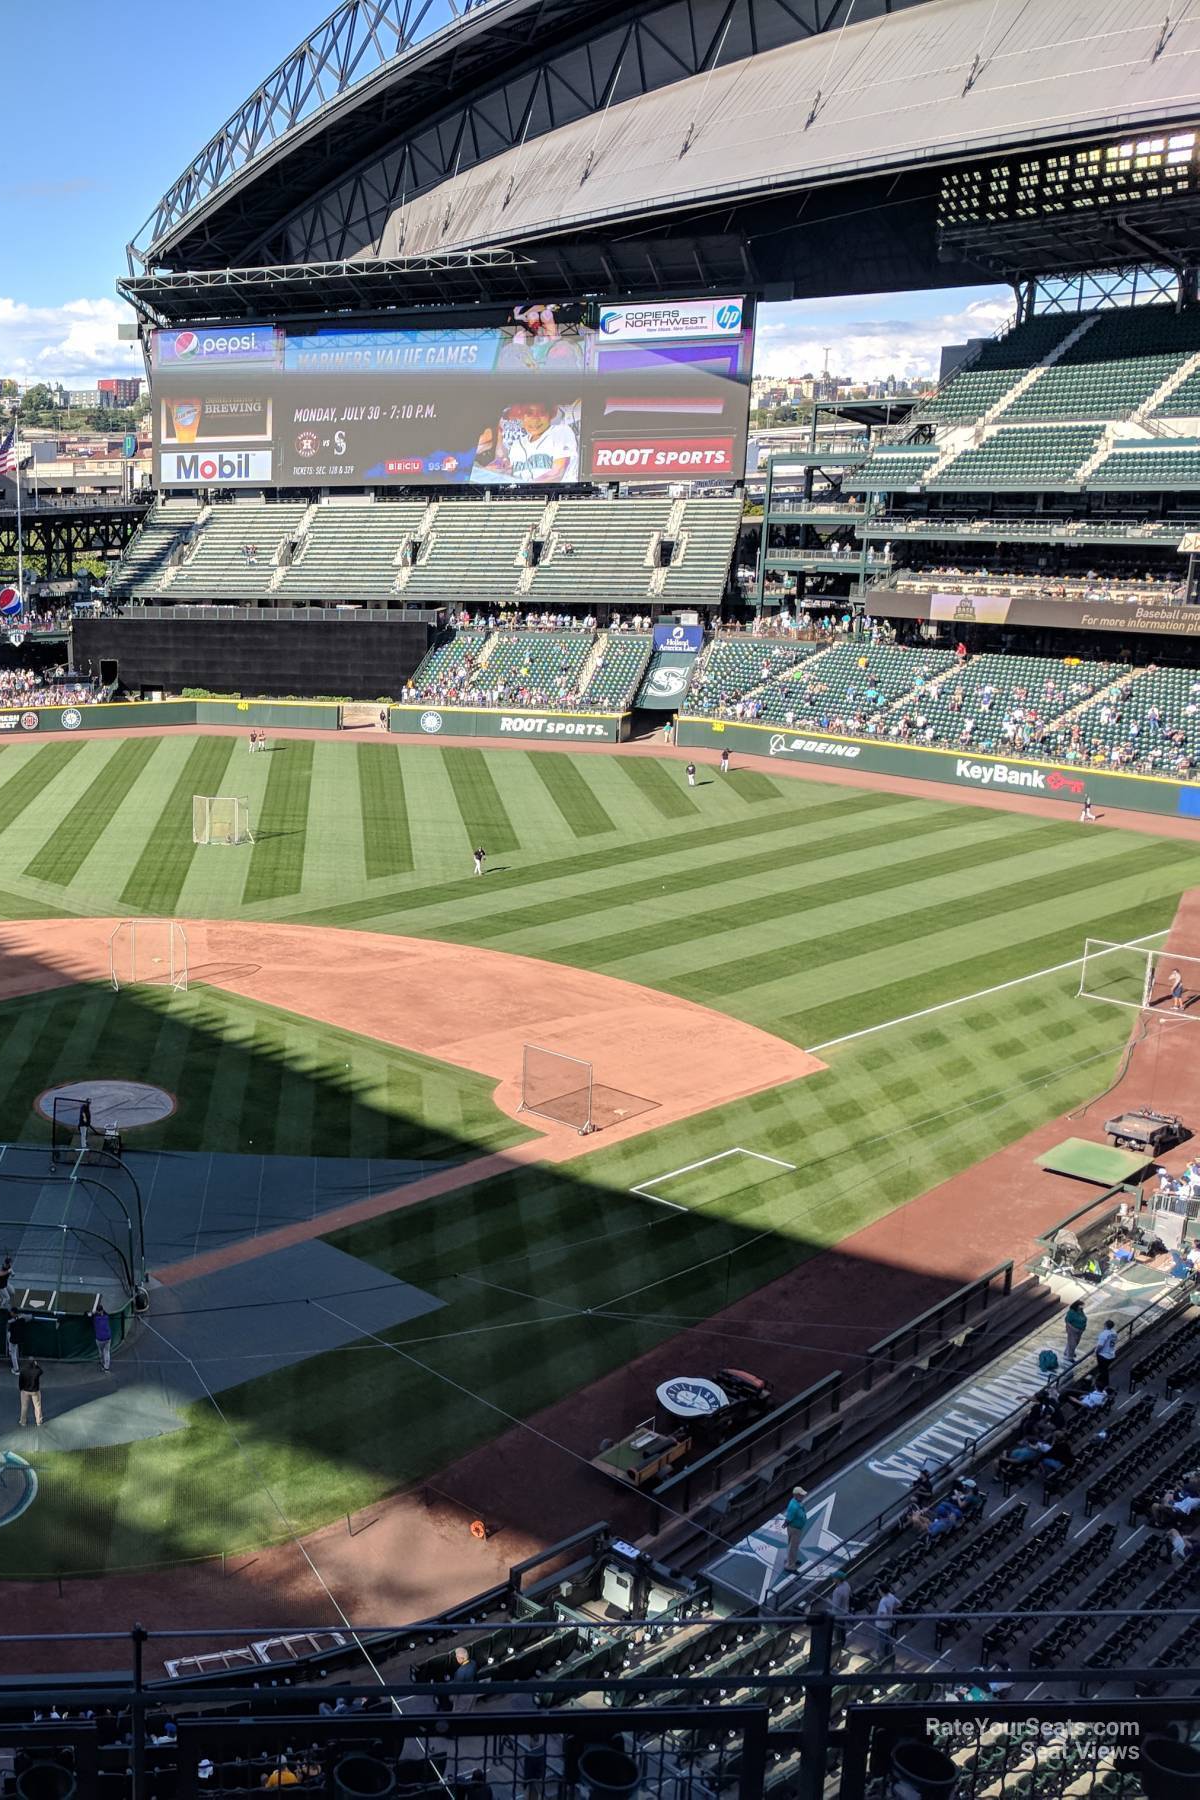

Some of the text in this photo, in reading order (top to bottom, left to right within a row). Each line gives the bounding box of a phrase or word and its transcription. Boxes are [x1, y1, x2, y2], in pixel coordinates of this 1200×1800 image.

[625, 310, 680, 320] COPIERS
[625, 316, 707, 328] NORTHWEST
[719, 305, 739, 330] hp
[203, 333, 256, 355] pepsi
[425, 346, 478, 364] GAMES
[204, 402, 261, 414] BREWING
[294, 407, 337, 423] MONDAY,
[340, 406, 366, 421] JULY
[367, 406, 380, 420] 30
[390, 405, 413, 420] 7:10
[415, 403, 437, 418] P.M.
[176, 453, 250, 479] Mobil
[597, 449, 726, 466] ROOT SPORTS
[1081, 614, 1099, 625] For
[1099, 618, 1126, 627] more
[1127, 617, 1185, 631] information
[1135, 607, 1180, 620] Baseball
[667, 638, 689, 646] Holland
[500, 717, 604, 736] ROOT SPORTS
[790, 739, 861, 758] BOEING
[956, 759, 1045, 789] KeyBank
